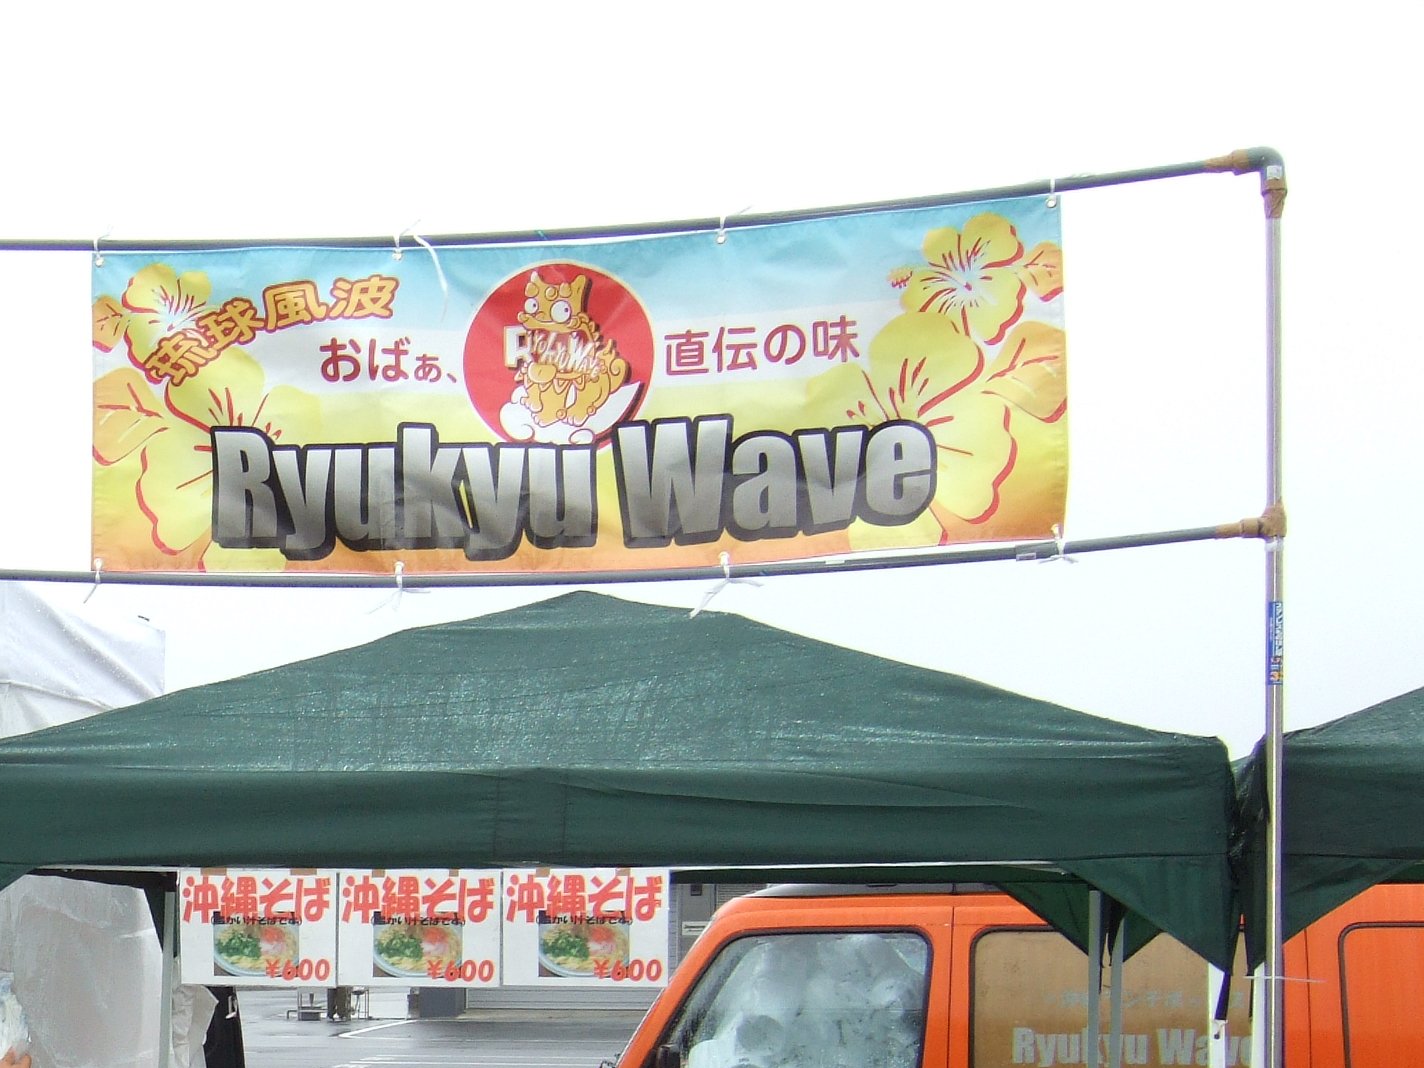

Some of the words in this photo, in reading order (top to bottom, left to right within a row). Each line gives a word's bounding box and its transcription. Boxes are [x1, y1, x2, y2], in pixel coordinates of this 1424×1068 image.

[143, 273, 401, 387] 琉球風波
[663, 314, 861, 376] 直伝の味
[210, 422, 598, 560] Ryukyu
[611, 413, 938, 550] Wave
[182, 874, 332, 924] 沖縄そば
[341, 874, 496, 924] 沖縄そば
[505, 873, 663, 924] 沖縄そば
[265, 958, 331, 981] ¥600
[427, 959, 495, 983] ¥600
[593, 958, 663, 983] ¥600
